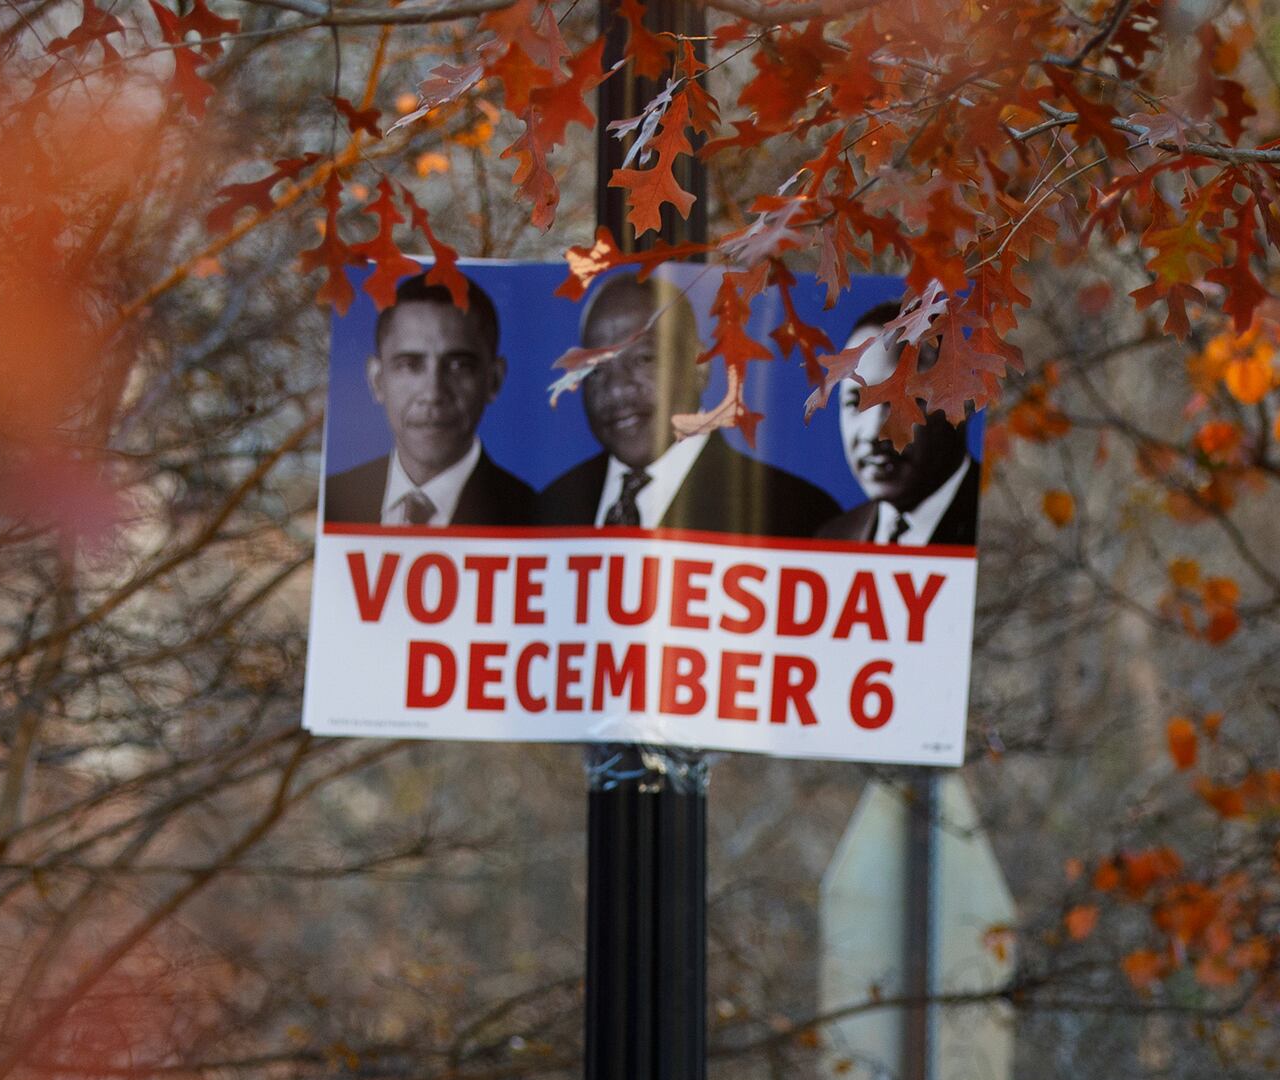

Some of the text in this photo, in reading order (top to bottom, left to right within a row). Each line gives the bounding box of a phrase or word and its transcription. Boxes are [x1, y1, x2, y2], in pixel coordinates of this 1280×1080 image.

[346, 551, 947, 644] VOTE TUESDAY
[405, 640, 895, 731] DECEMBER 6
